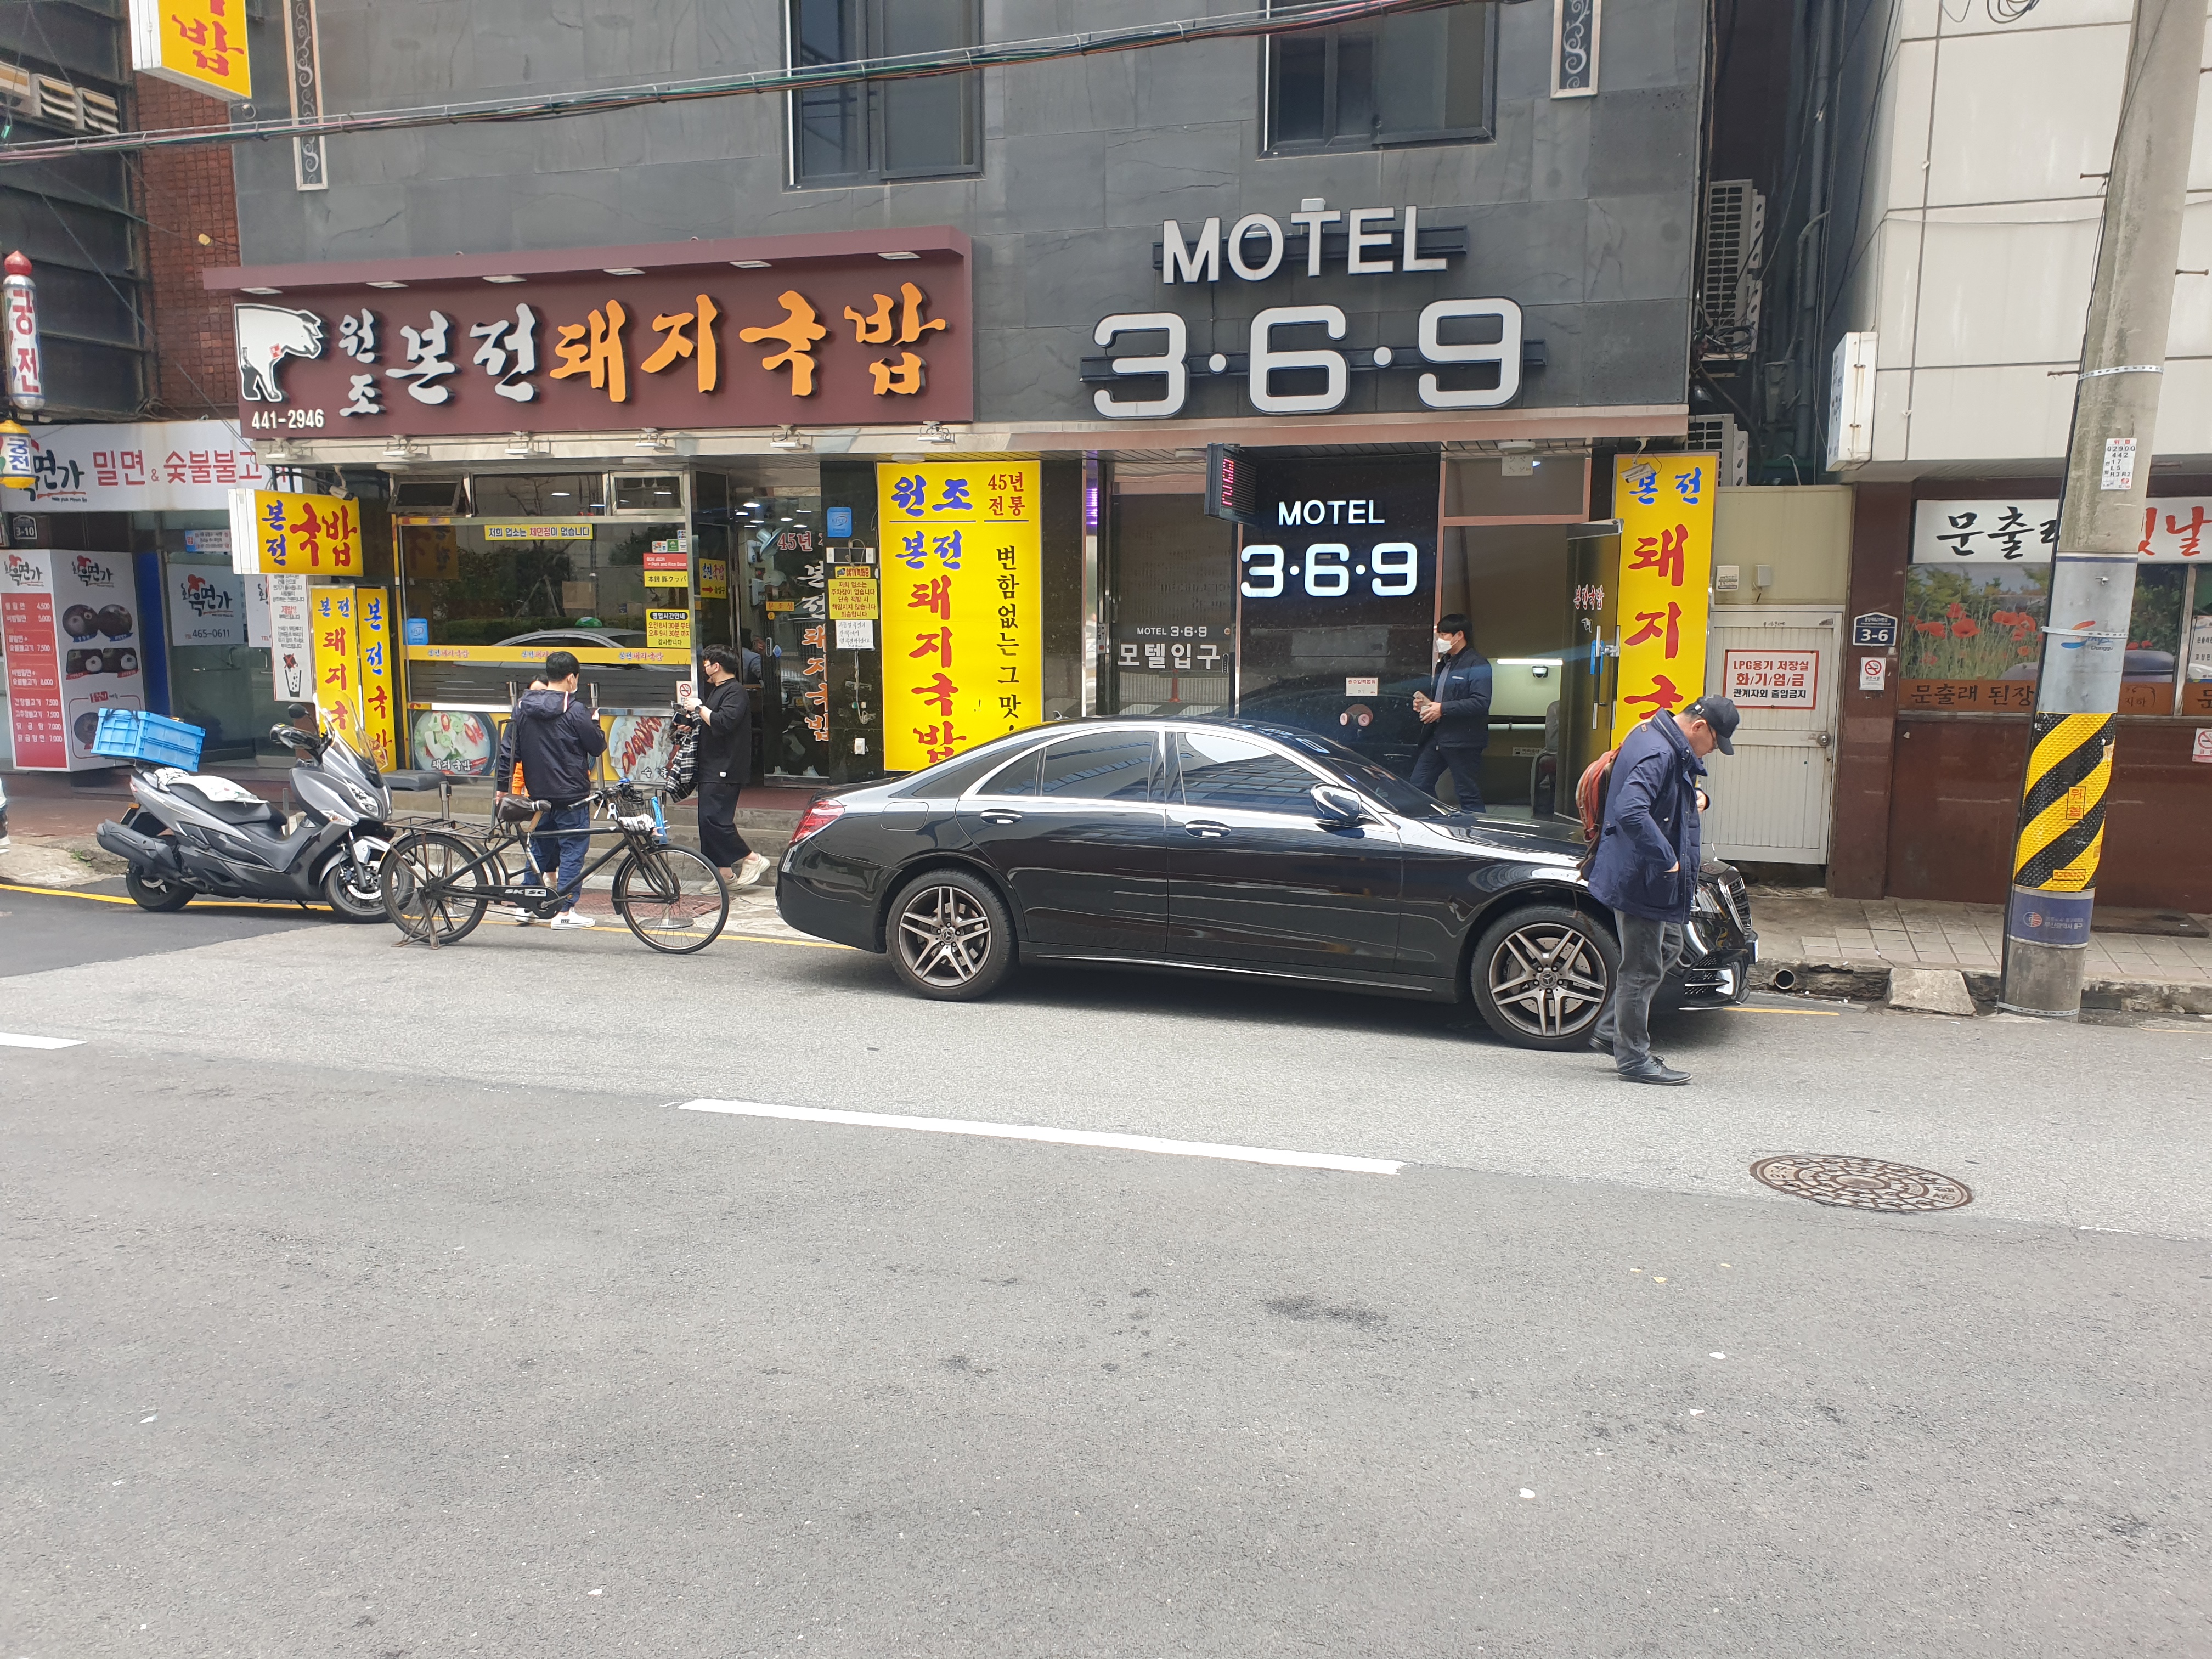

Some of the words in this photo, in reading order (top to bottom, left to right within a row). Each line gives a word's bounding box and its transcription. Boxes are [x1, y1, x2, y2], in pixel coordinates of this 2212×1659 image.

[171, 0, 245, 77] 밥
[1163, 205, 1448, 284] MOTEL
[13, 289, 40, 393] 궁전
[252, 409, 325, 429] 441-2946
[8, 439, 30, 472] 궁전
[92, 450, 146, 486] 밀면
[151, 469, 160, 482] &
[988, 471, 1025, 493] 45년
[1628, 467, 1703, 505] 본전
[890, 474, 973, 517] 원조
[988, 495, 1026, 516] 전통
[1278, 499, 1386, 526] MOTEL
[289, 501, 358, 567] 국밥
[488, 527, 503, 537] 저희
[505, 527, 527, 537] 업소는
[529, 527, 558, 537] 체인점이
[561, 527, 590, 537] 없습니다
[777, 532, 813, 551] 45년
[895, 529, 963, 570] 본전
[318, 596, 350, 618] 본전
[996, 544, 1020, 657] 변함없는
[652, 612, 685, 620] 영업시간안내
[1623, 523, 1689, 721] 돼지국
[193, 628, 230, 638] 465-0611
[1137, 627, 1167, 636] MOTEL
[1860, 629, 1889, 642] 3-6
[1118, 643, 1221, 670] 모텔입구
[1733, 660, 1773, 671] LPG용기
[1777, 660, 1809, 672] 저장실
[907, 574, 967, 764] 돼지국밥
[997, 665, 1020, 685] 그
[1733, 689, 1768, 698] 관계자외
[1771, 689, 1807, 699] 출입금지
[1910, 684, 1978, 706] 문출래
[1988, 685, 2034, 706] 된장
[432, 758, 472, 771] 돼지국밥
